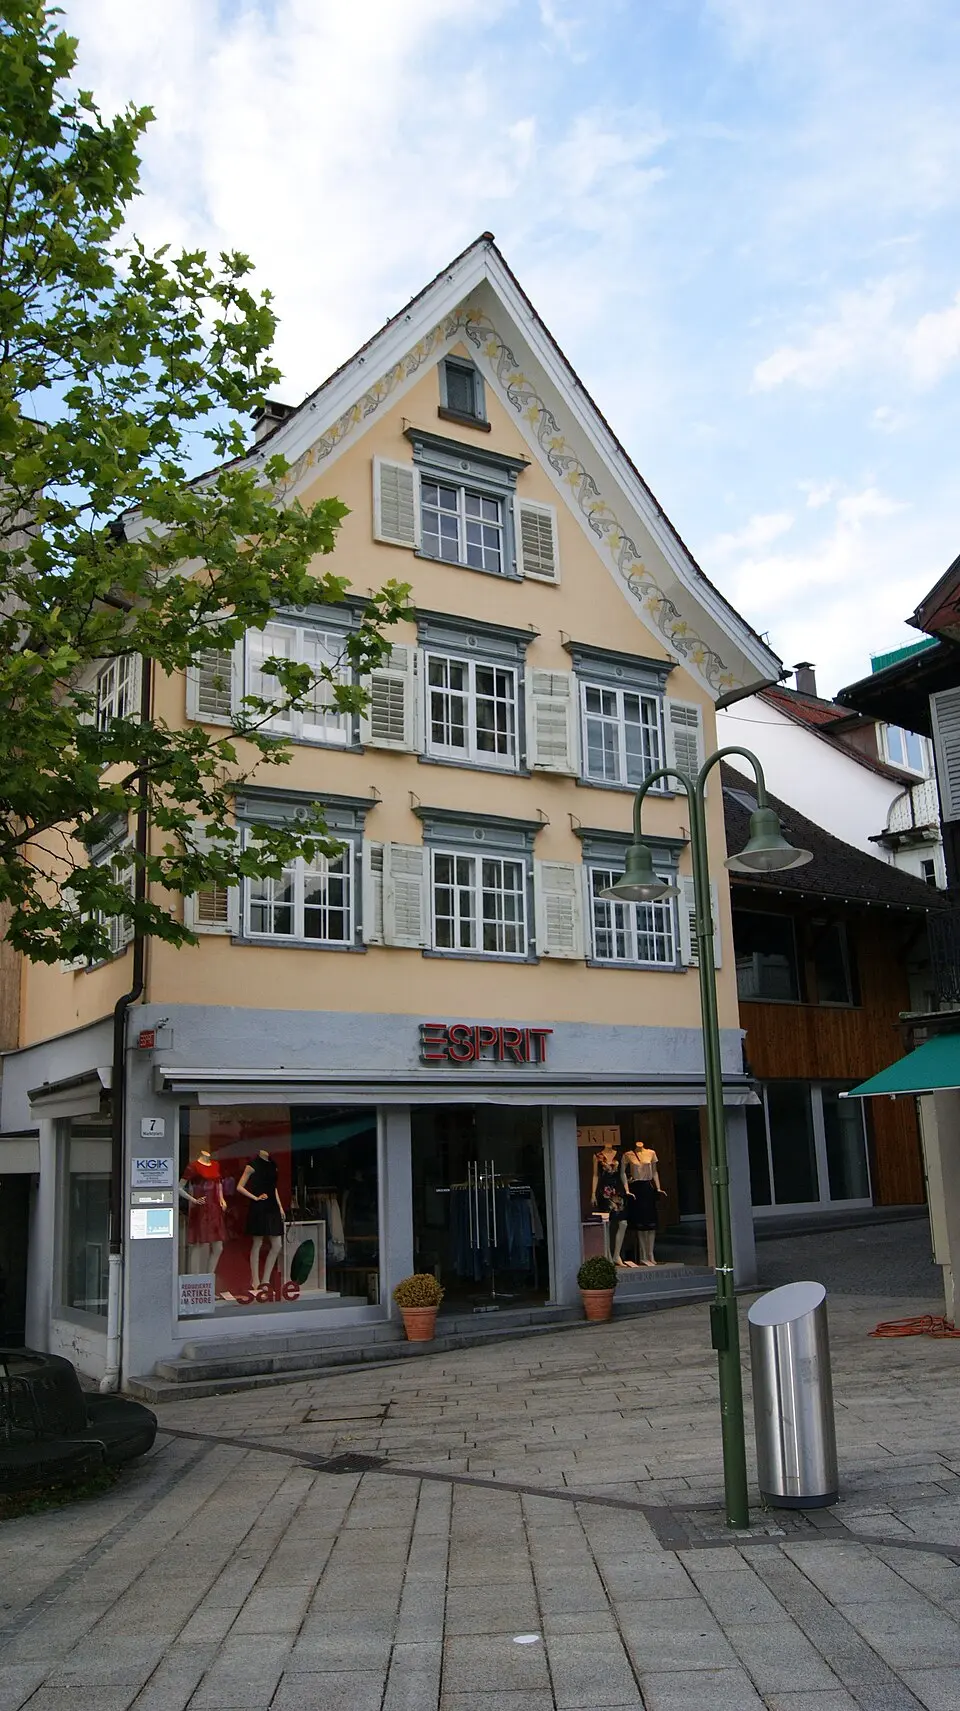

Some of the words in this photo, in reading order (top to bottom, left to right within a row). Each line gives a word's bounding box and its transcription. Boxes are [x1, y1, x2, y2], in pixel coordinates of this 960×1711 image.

[420, 1023, 553, 1062] ESPRIT
[150, 1120, 156, 1131] 7
[181, 1289, 211, 1298] ARTIKEL
